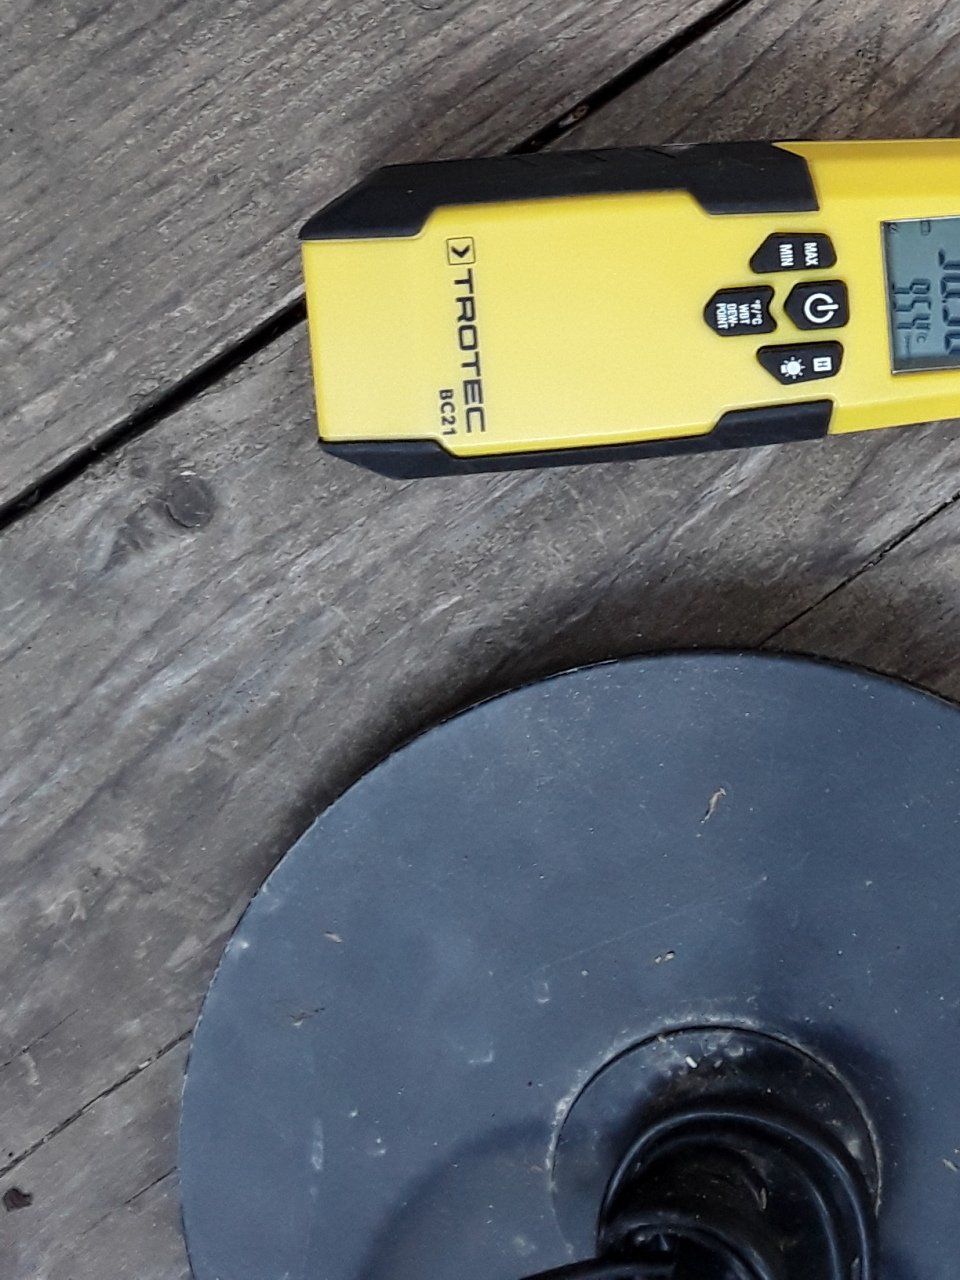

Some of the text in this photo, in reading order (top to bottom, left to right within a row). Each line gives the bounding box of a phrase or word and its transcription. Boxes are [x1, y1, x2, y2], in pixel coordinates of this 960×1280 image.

[779, 243, 794, 267] MIN
[804, 241, 819, 267] MAX
[715, 302, 728, 329] POINT
[738, 303, 750, 325] WBT
[453, 267, 486, 434] TROTEC
[438, 388, 457, 436] BC21
